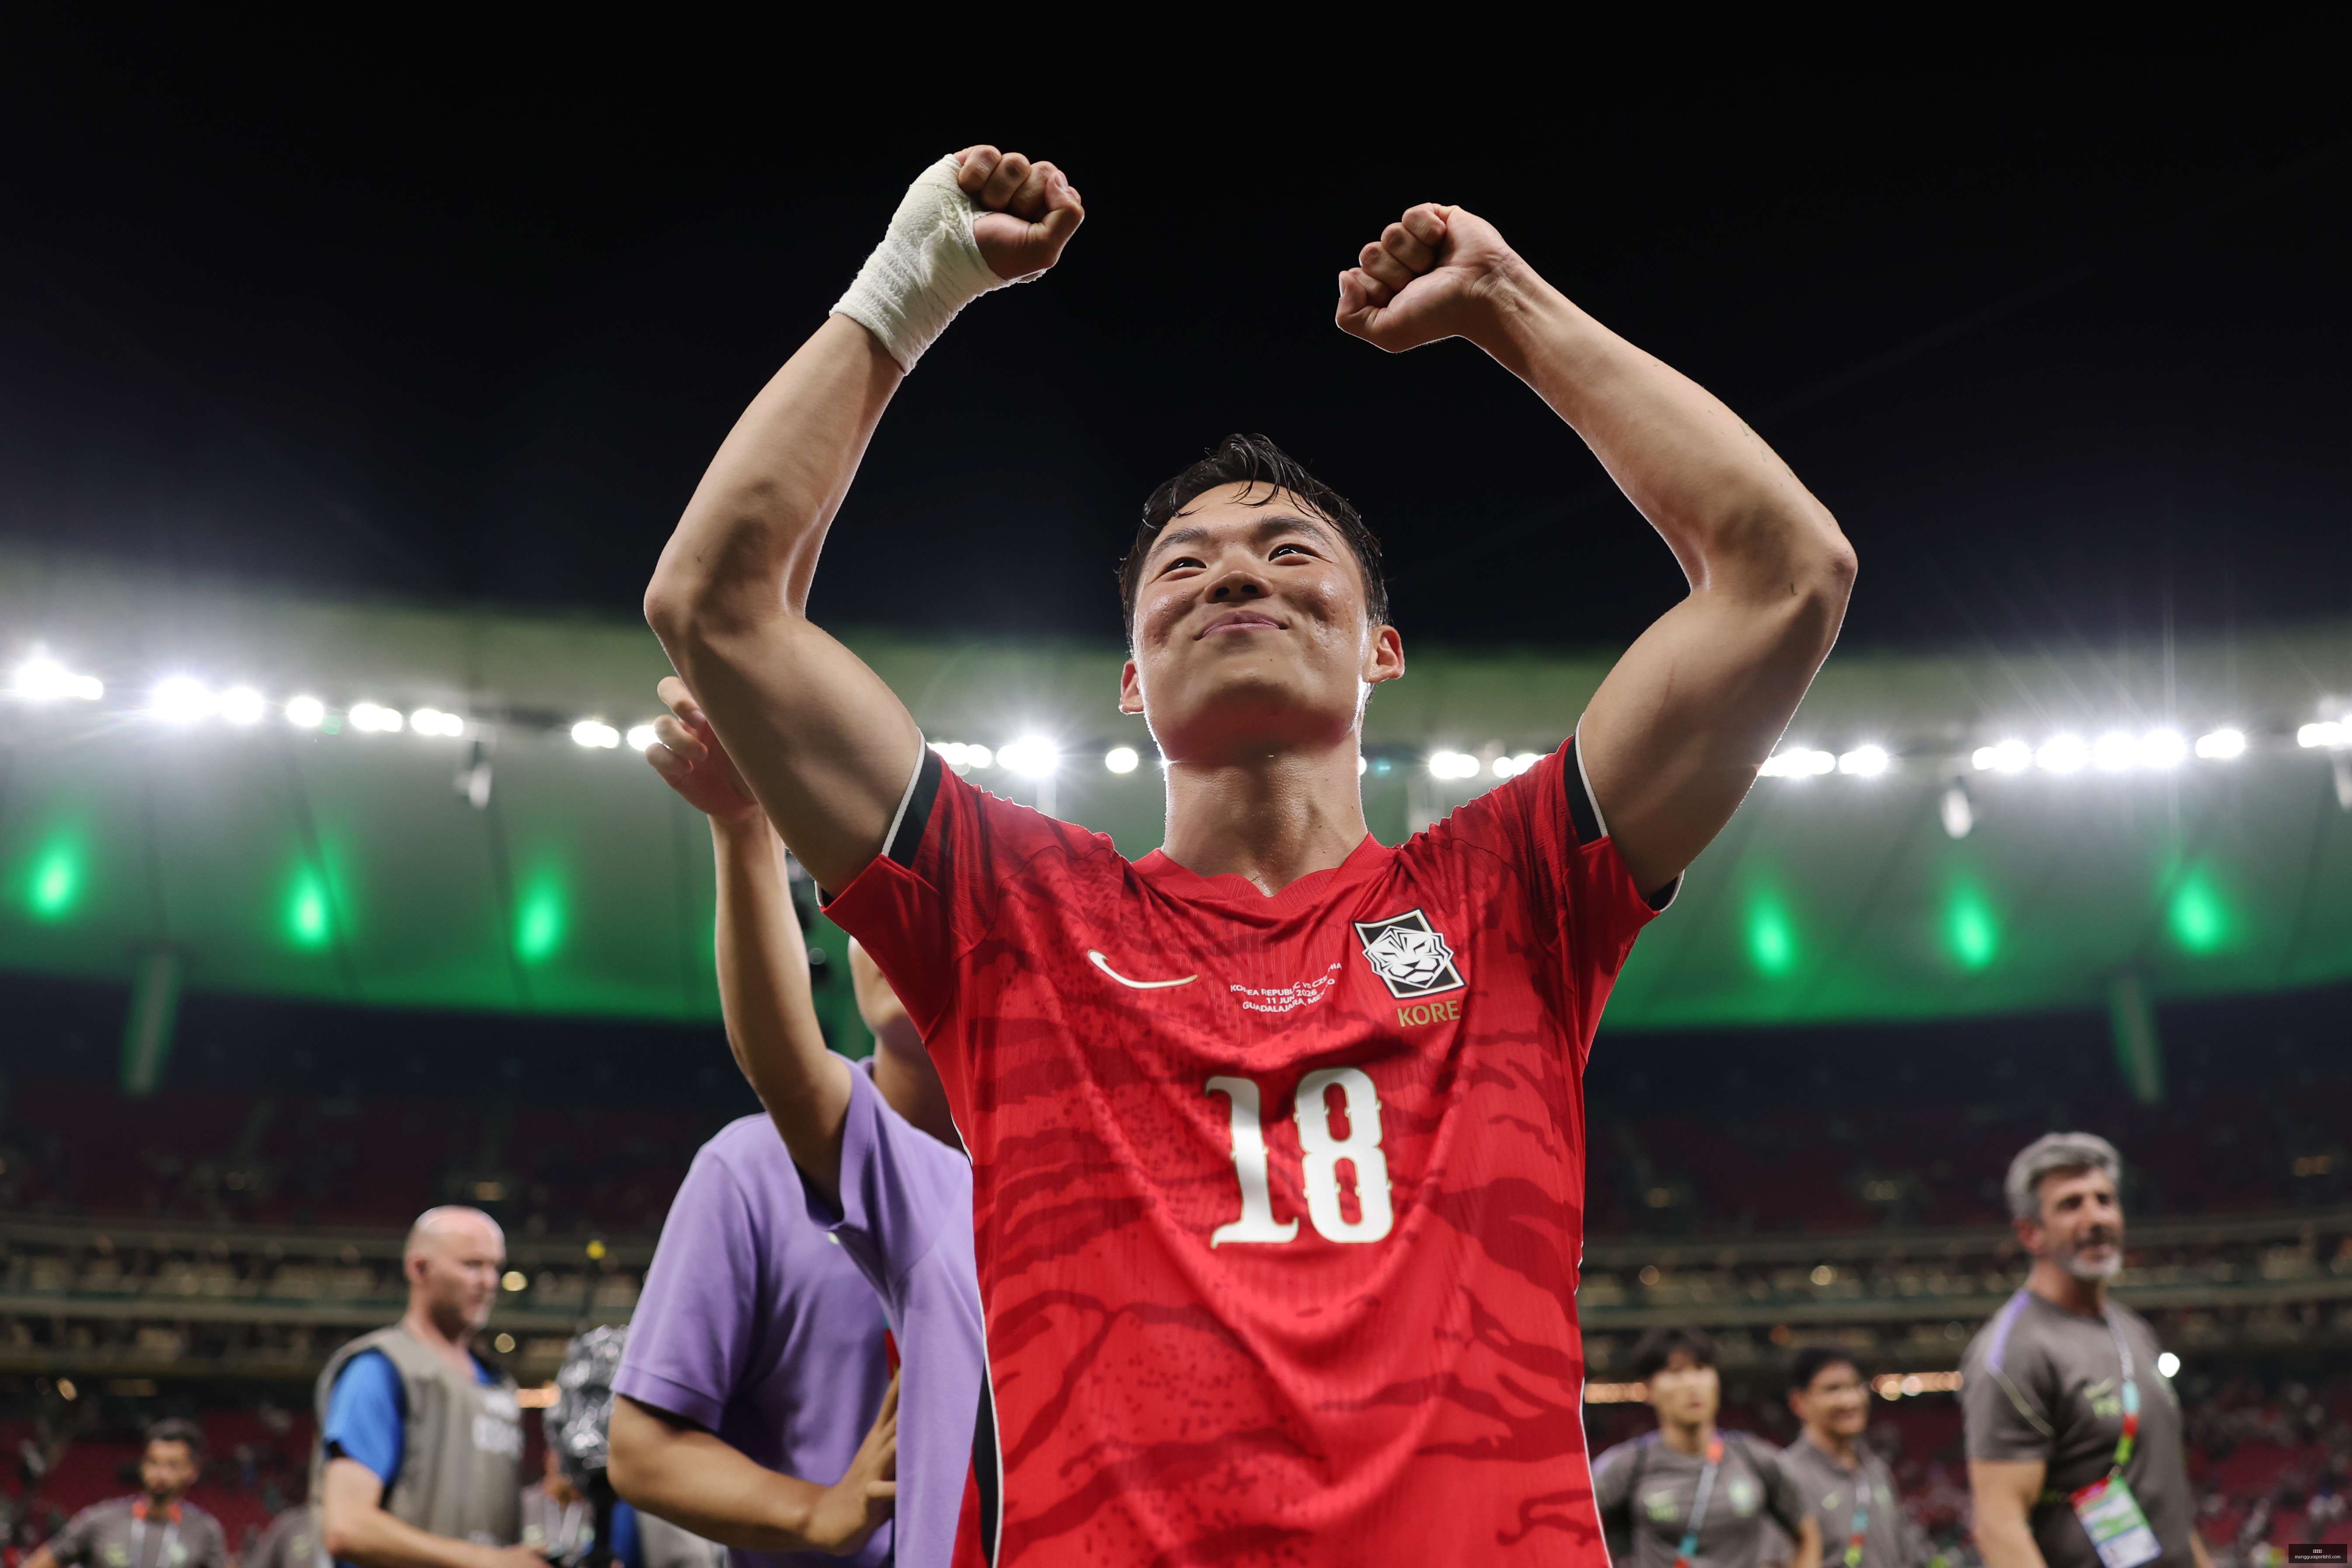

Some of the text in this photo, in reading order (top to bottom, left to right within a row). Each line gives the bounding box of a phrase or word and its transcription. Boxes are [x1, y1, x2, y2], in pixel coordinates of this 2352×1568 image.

[1261, 981, 1301, 996] REPUBLIC
[1242, 998, 1306, 1012] GUADALAJARA,
[1280, 994, 1295, 1004] JUN
[1397, 1000, 1460, 1027] KORE
[1205, 1066, 1393, 1249] 18
